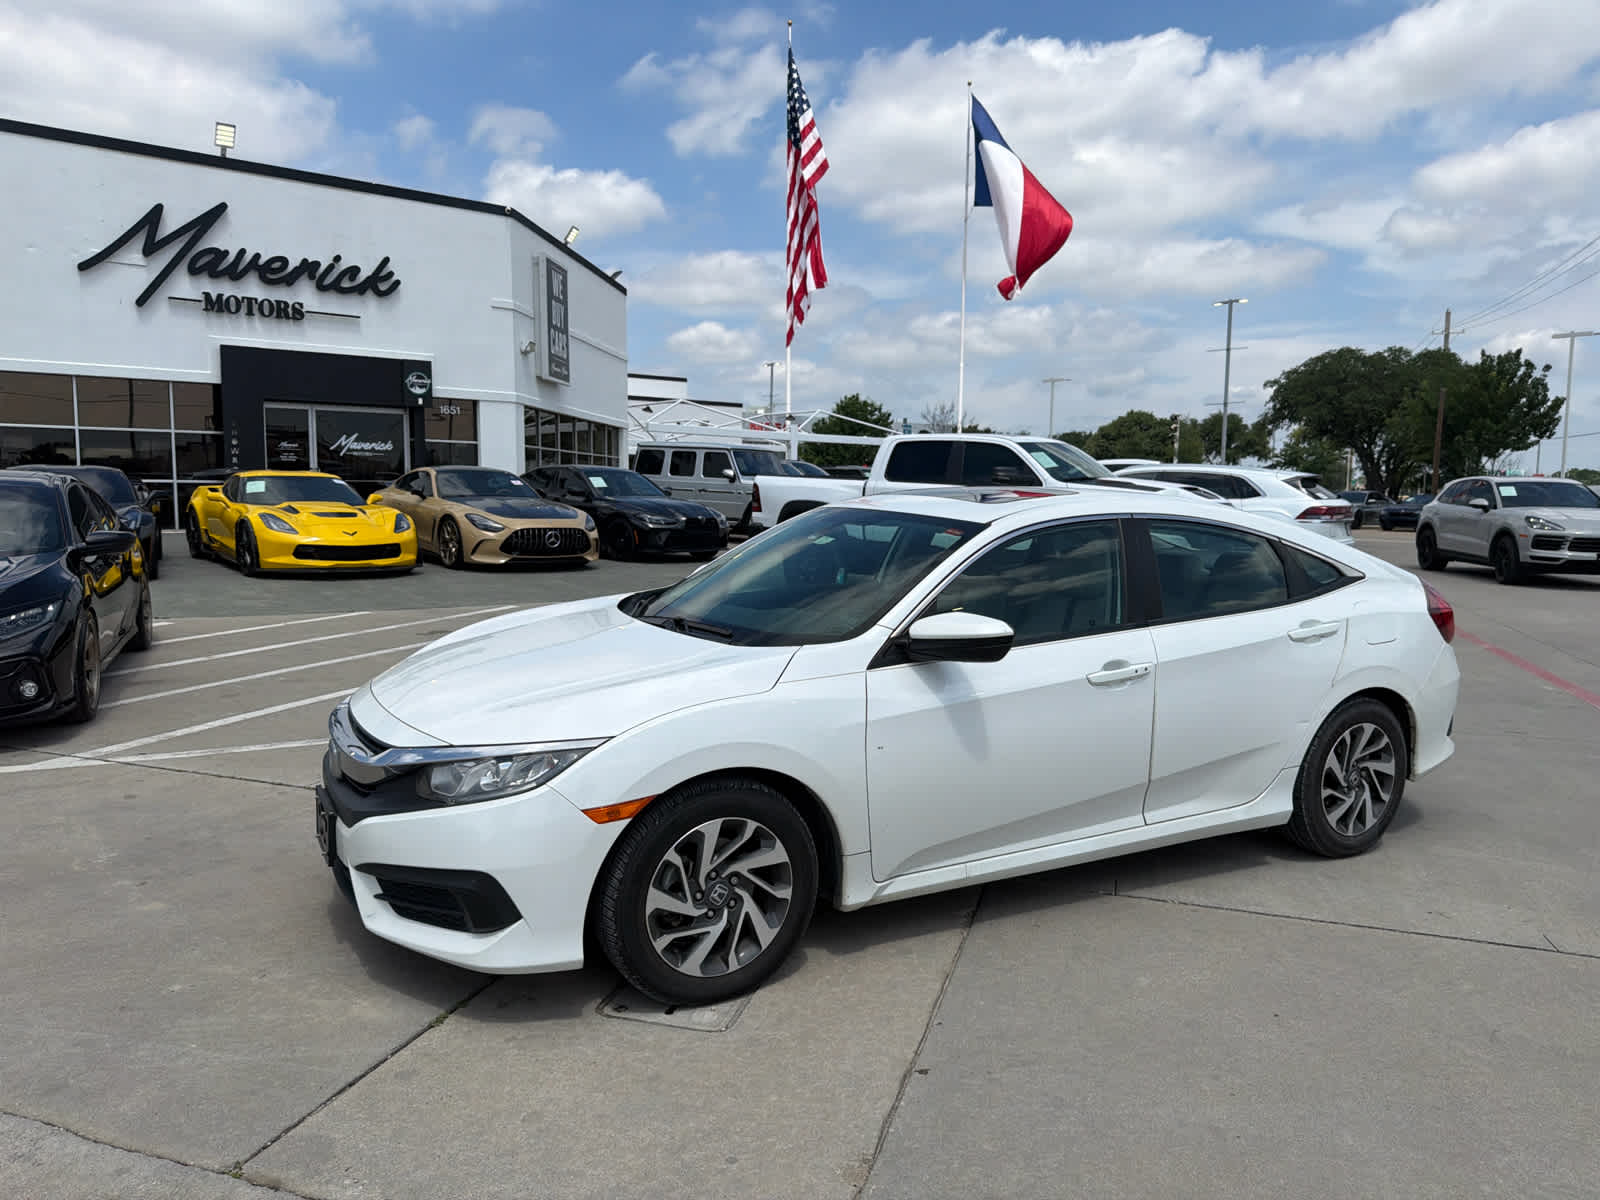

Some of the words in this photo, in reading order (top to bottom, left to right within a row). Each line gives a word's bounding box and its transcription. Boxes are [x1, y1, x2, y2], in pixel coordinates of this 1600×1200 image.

[77, 201, 402, 308] Maverick
[202, 291, 306, 321] MOTORS
[440, 404, 461, 416] 1651
[329, 432, 394, 457] Maverick
